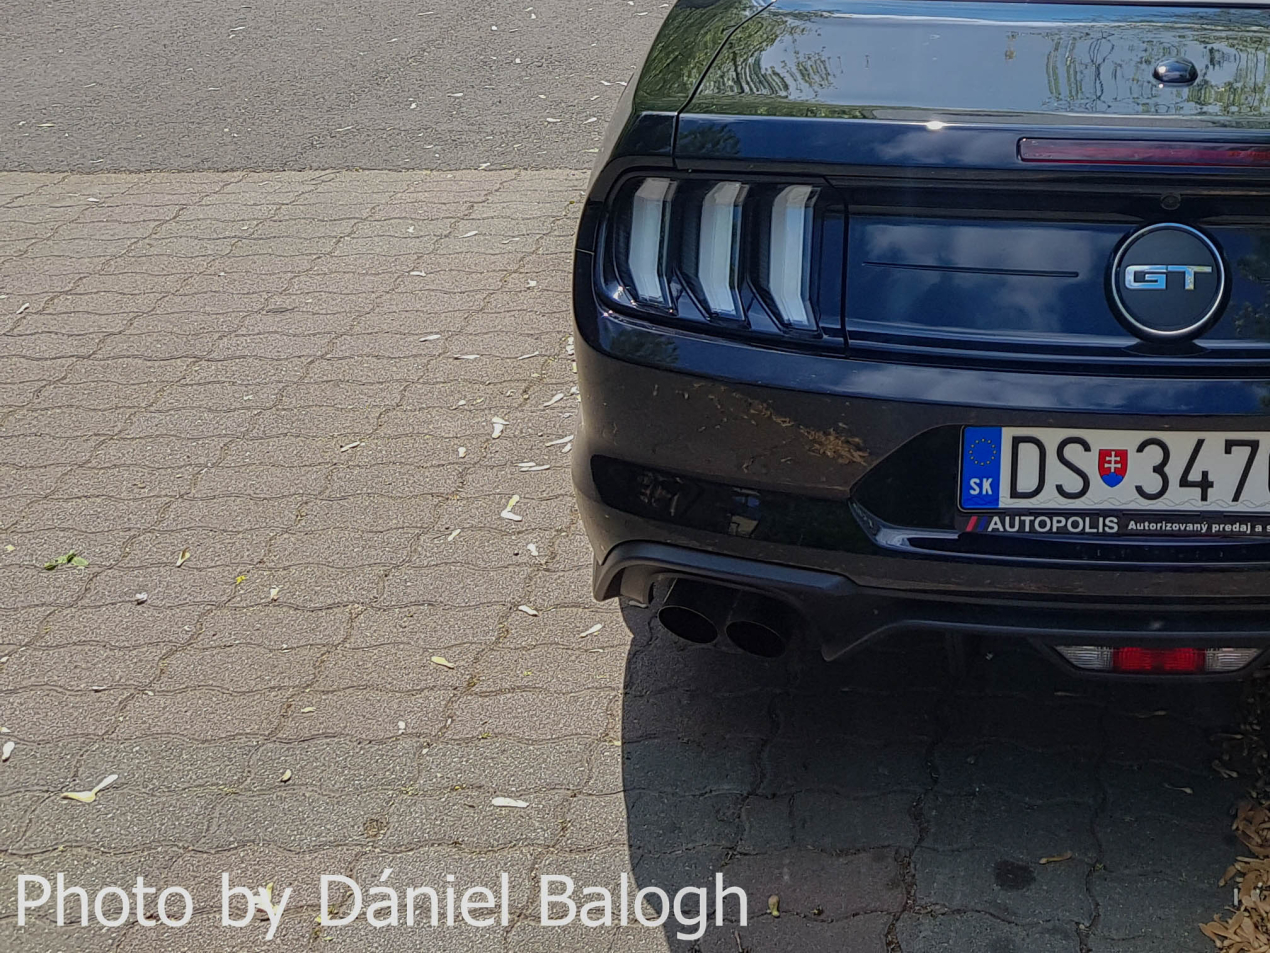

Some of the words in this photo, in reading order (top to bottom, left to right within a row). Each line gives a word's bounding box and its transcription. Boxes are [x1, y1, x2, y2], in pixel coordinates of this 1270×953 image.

[1125, 265, 1212, 290] GT
[969, 478, 993, 495] SK
[987, 517, 1119, 533] AUTOPOLIS
[1127, 520, 1208, 534] Autorizovaný
[1211, 522, 1251, 535] predaj
